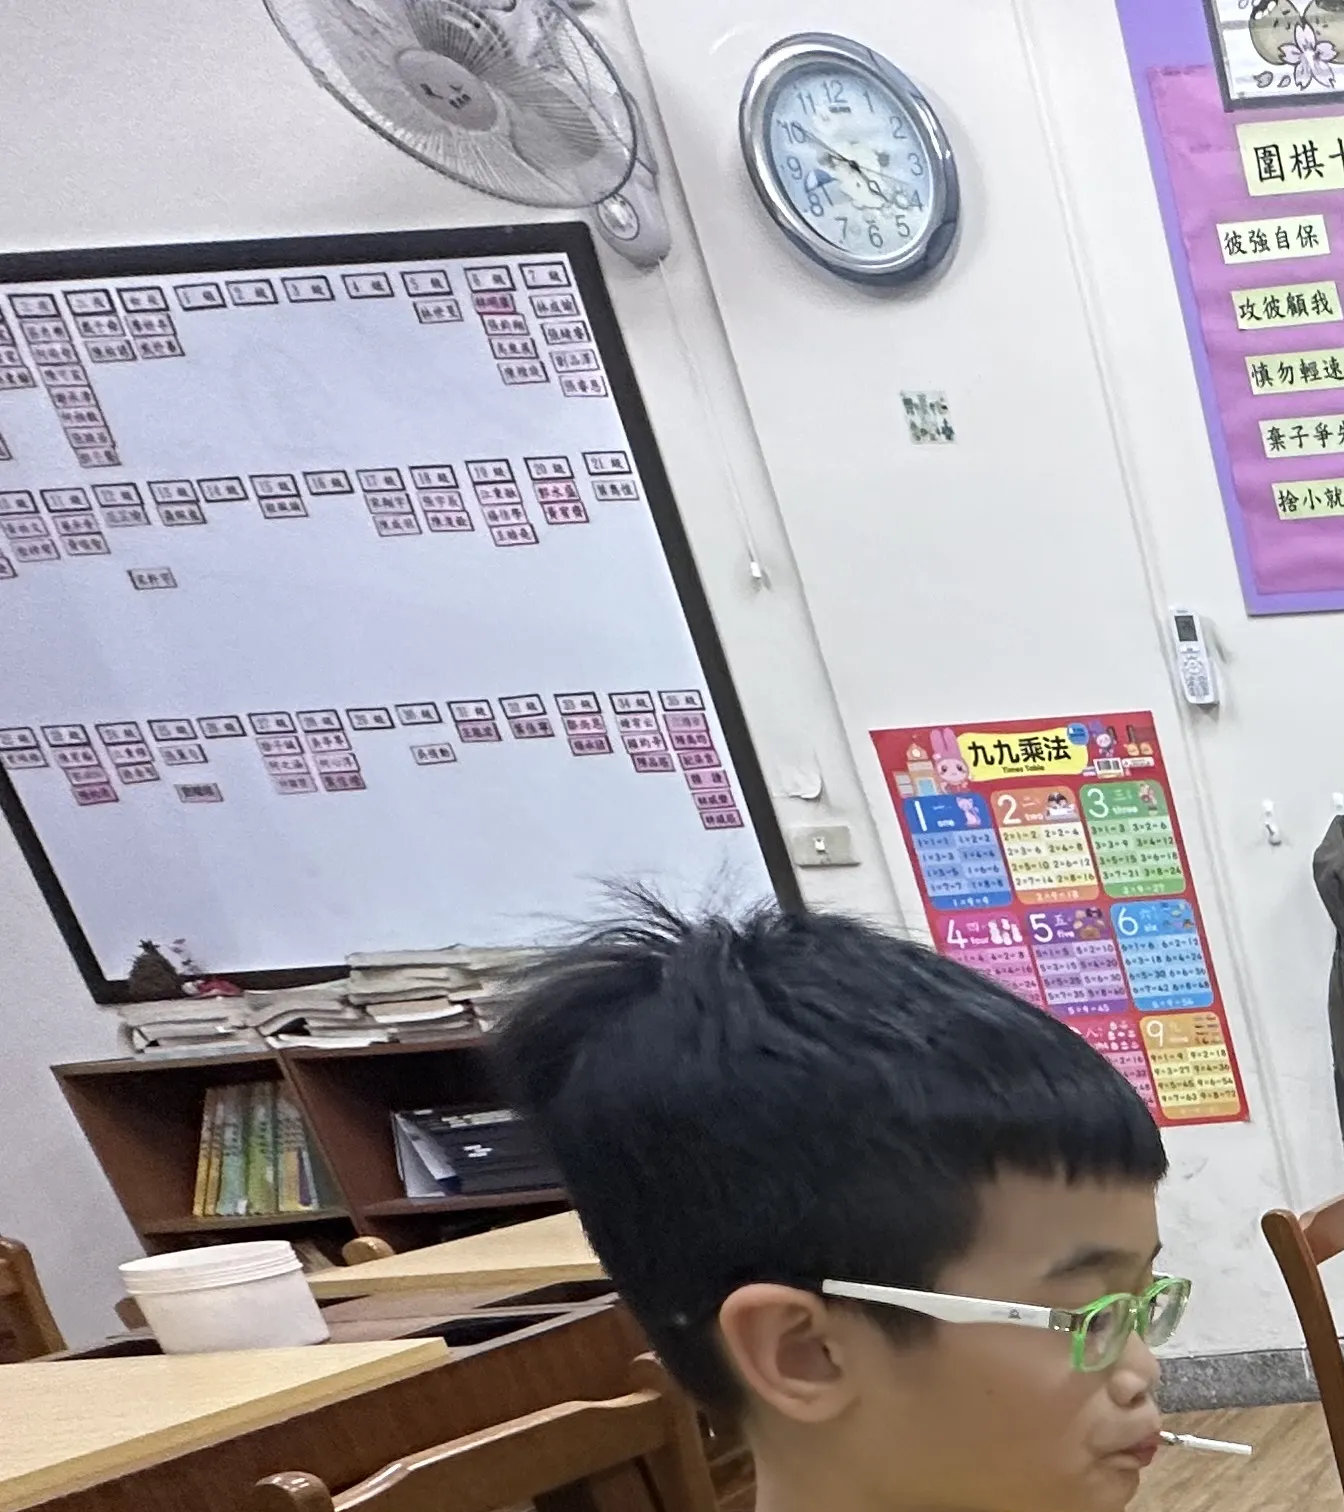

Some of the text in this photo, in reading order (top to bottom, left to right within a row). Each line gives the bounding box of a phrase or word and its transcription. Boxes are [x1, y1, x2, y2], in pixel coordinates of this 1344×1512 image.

[797, 91, 817, 115] 11
[823, 79, 848, 103] 12
[863, 90, 874, 113] 1
[778, 119, 806, 144] 10
[890, 115, 908, 139] 2
[787, 156, 802, 180] 9
[907, 152, 923, 176] 3
[807, 192, 824, 217] 8
[909, 189, 924, 212] 4
[834, 216, 848, 239] 7
[868, 223, 884, 248] 6
[895, 214, 910, 237] 5
[1224, 223, 1320, 256] 彼強自保
[1238, 289, 1334, 322] 攻彼顧我
[968, 735, 1072, 767] 九九乘法
[914, 800, 927, 831] 1
[997, 794, 1022, 824] 2
[1087, 788, 1109, 818] 3
[1029, 913, 1053, 943] 5
[1117, 906, 1139, 936] 6
[947, 919, 968, 949] 4
[1146, 1020, 1164, 1048] 9
